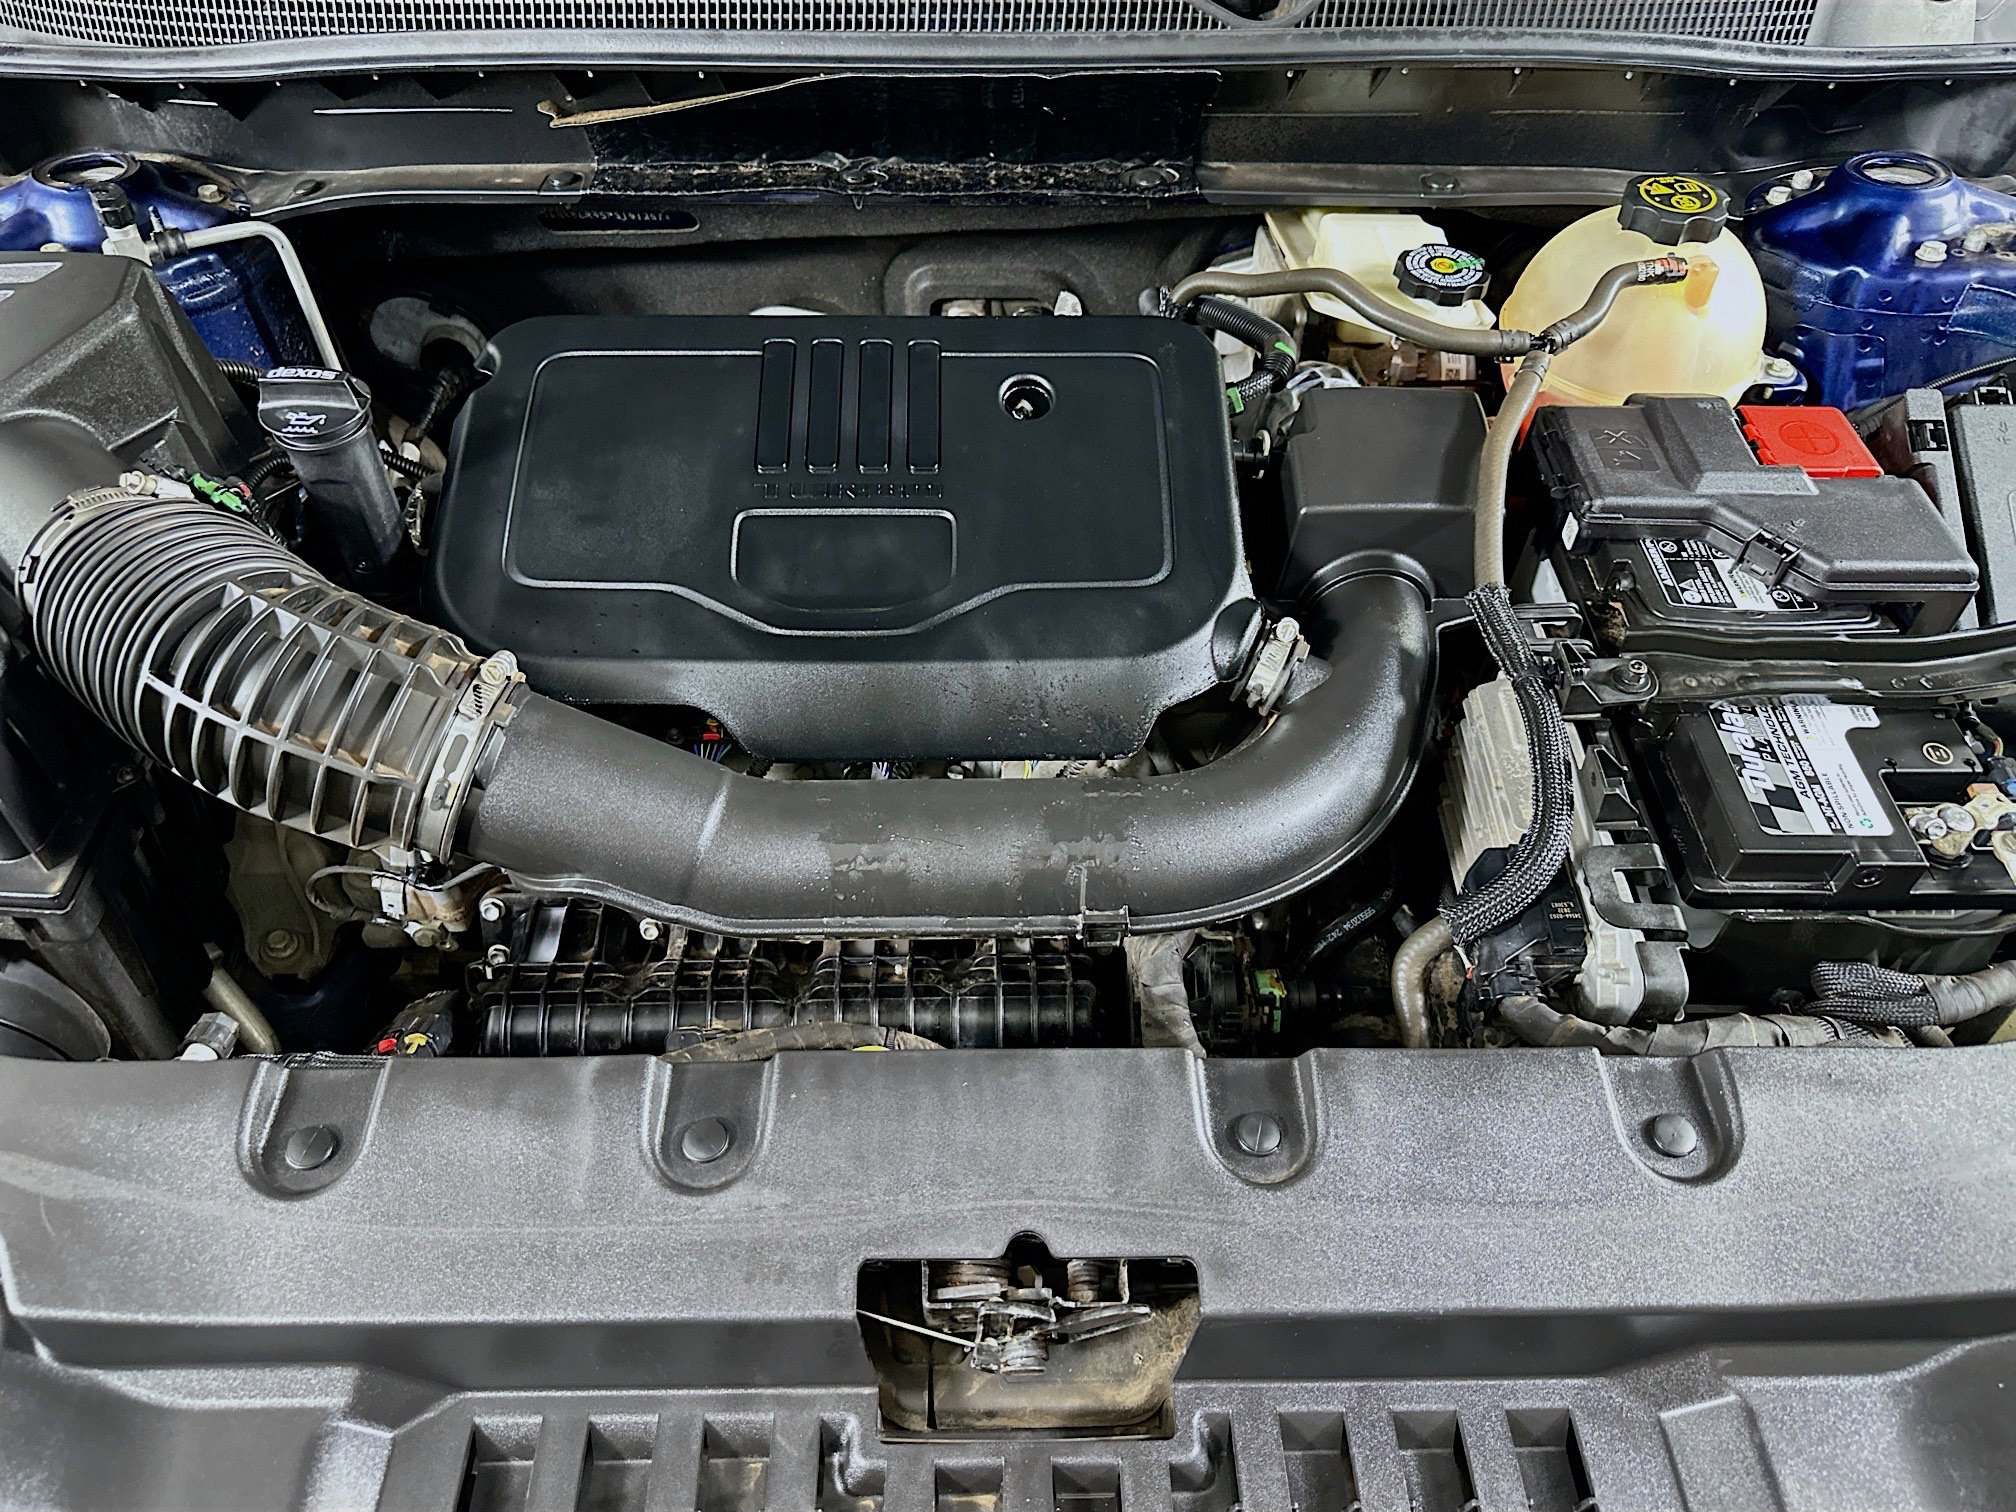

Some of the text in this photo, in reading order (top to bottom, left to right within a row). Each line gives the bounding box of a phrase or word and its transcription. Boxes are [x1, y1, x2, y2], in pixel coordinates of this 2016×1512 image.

[266, 366, 340, 380] dexos
[1717, 704, 1777, 795] Duralas
[1789, 769, 1811, 799] AGM
